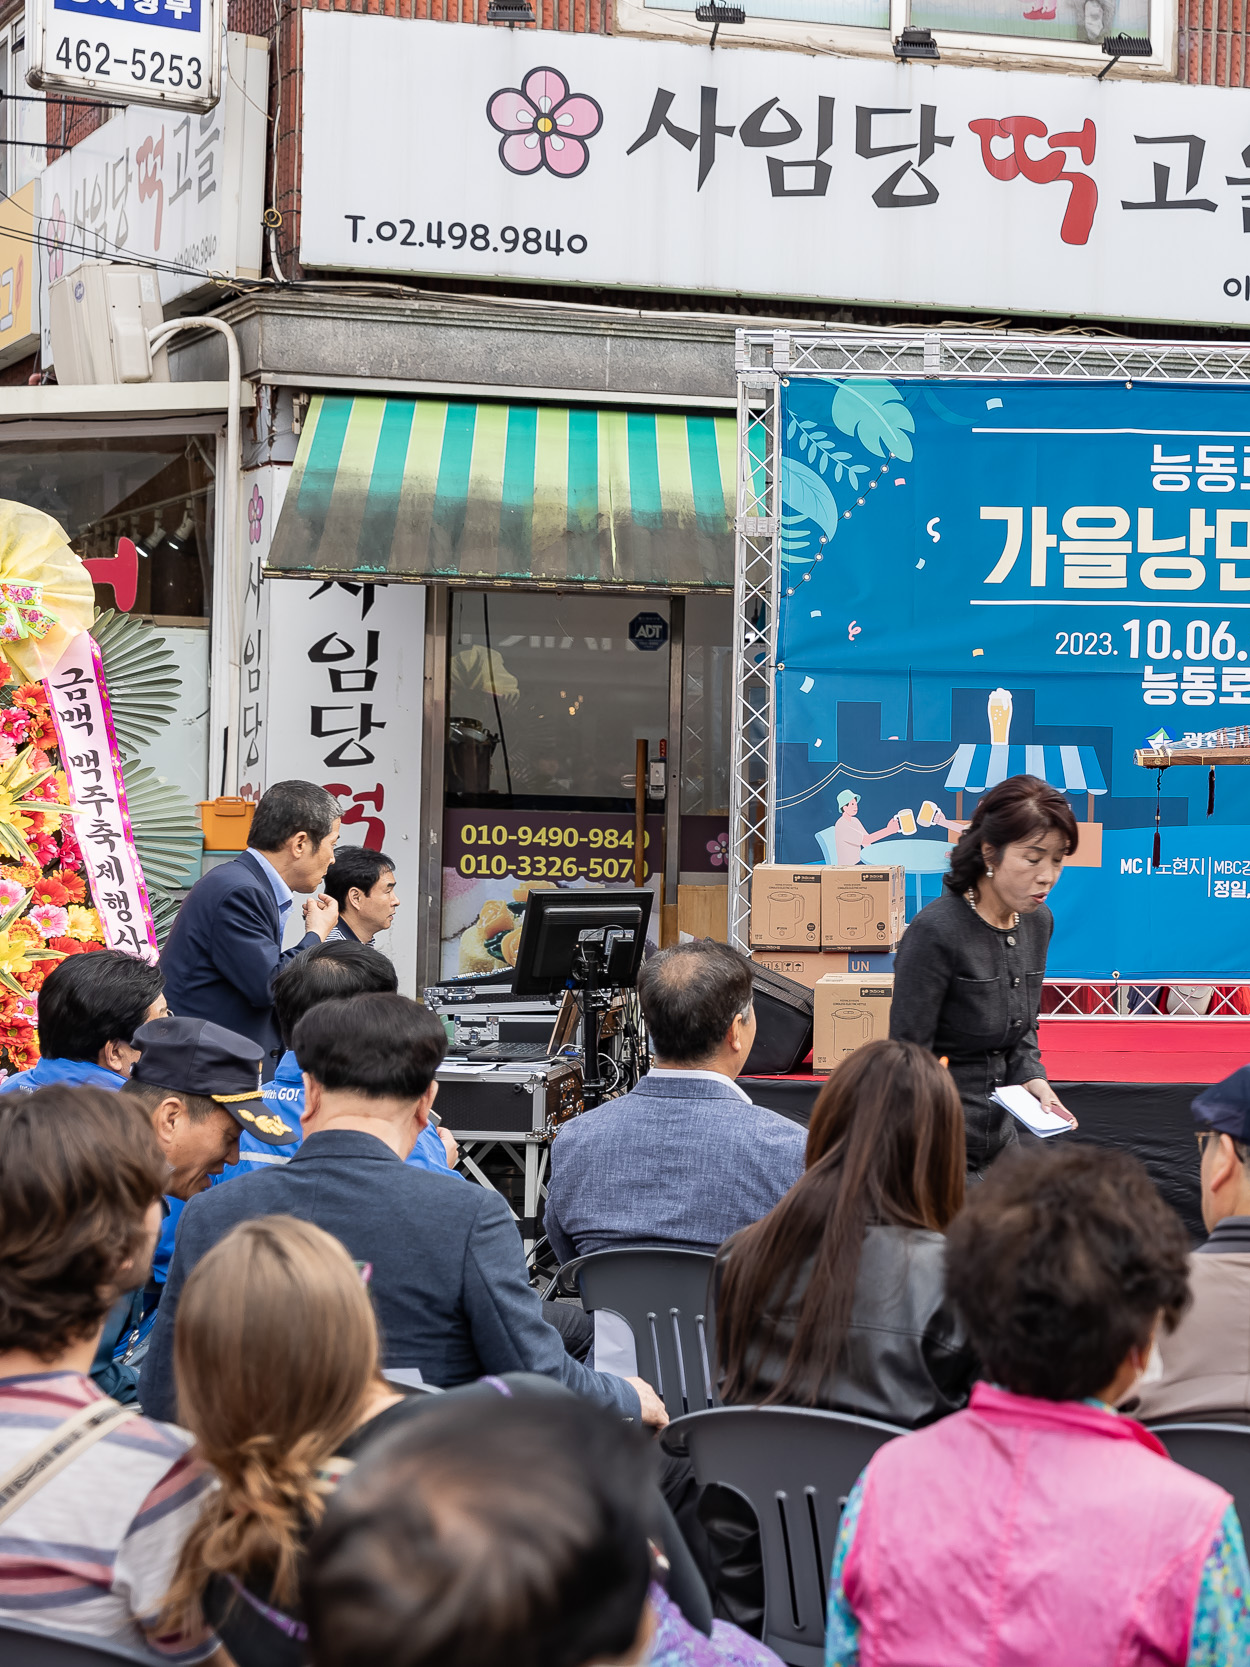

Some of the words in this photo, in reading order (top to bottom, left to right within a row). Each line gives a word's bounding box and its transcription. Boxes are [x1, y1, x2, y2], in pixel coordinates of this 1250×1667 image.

[56, 37, 201, 89] 462-5253
[344, 214, 588, 255] T.02.498.9840
[635, 624, 662, 638] ADT
[1055, 632, 1119, 657] 2023.
[52, 667, 94, 737] 금맥
[1120, 858, 1143, 875] MC
[1213, 880, 1250, 899] 정일,
[278, 1087, 301, 1102] GO!
